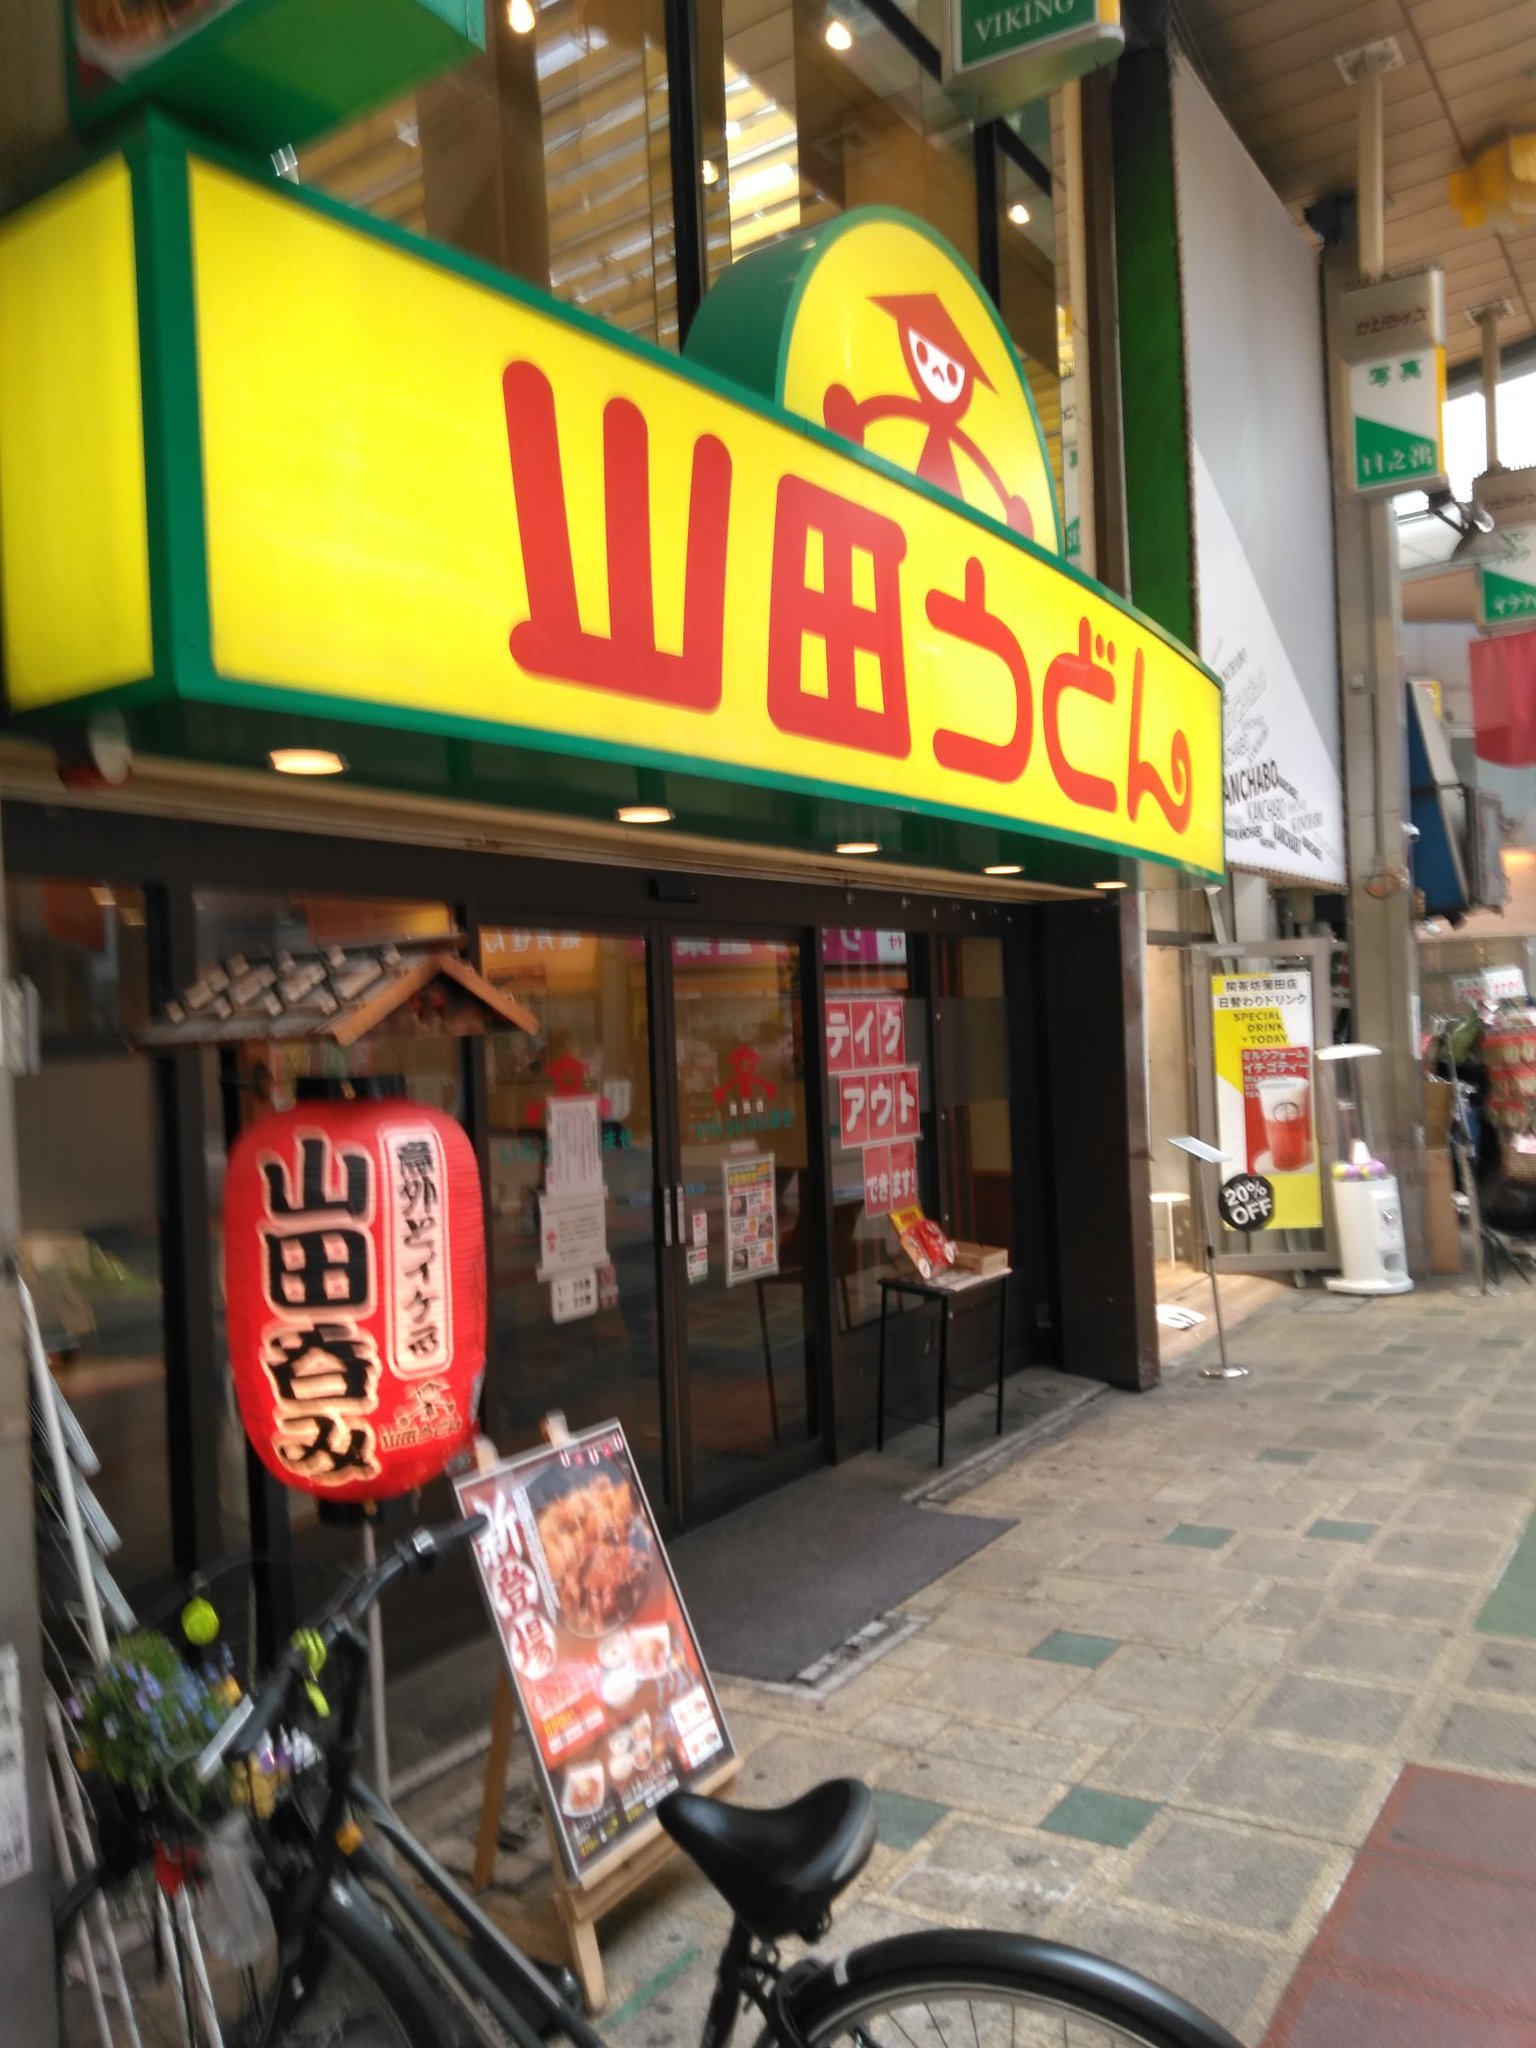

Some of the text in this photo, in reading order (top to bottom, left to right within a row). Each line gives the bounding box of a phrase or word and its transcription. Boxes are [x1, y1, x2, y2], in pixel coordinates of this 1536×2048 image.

[502, 359, 1193, 835] 山田うどん
[1219, 994, 1307, 1008] 日替わりドリンク
[1233, 1011, 1282, 1022] SPECIAL
[1247, 1023, 1285, 1033] DRINK
[826, 1010, 901, 1059] テイク
[1249, 1034, 1288, 1045] TODAY
[1244, 1061, 1309, 1075] イチゴティー
[844, 1081, 915, 1132] アウト
[1224, 1179, 1267, 1207] 20%
[1231, 1197, 1272, 1225] OFF
[473, 1487, 556, 1675] 新登場
